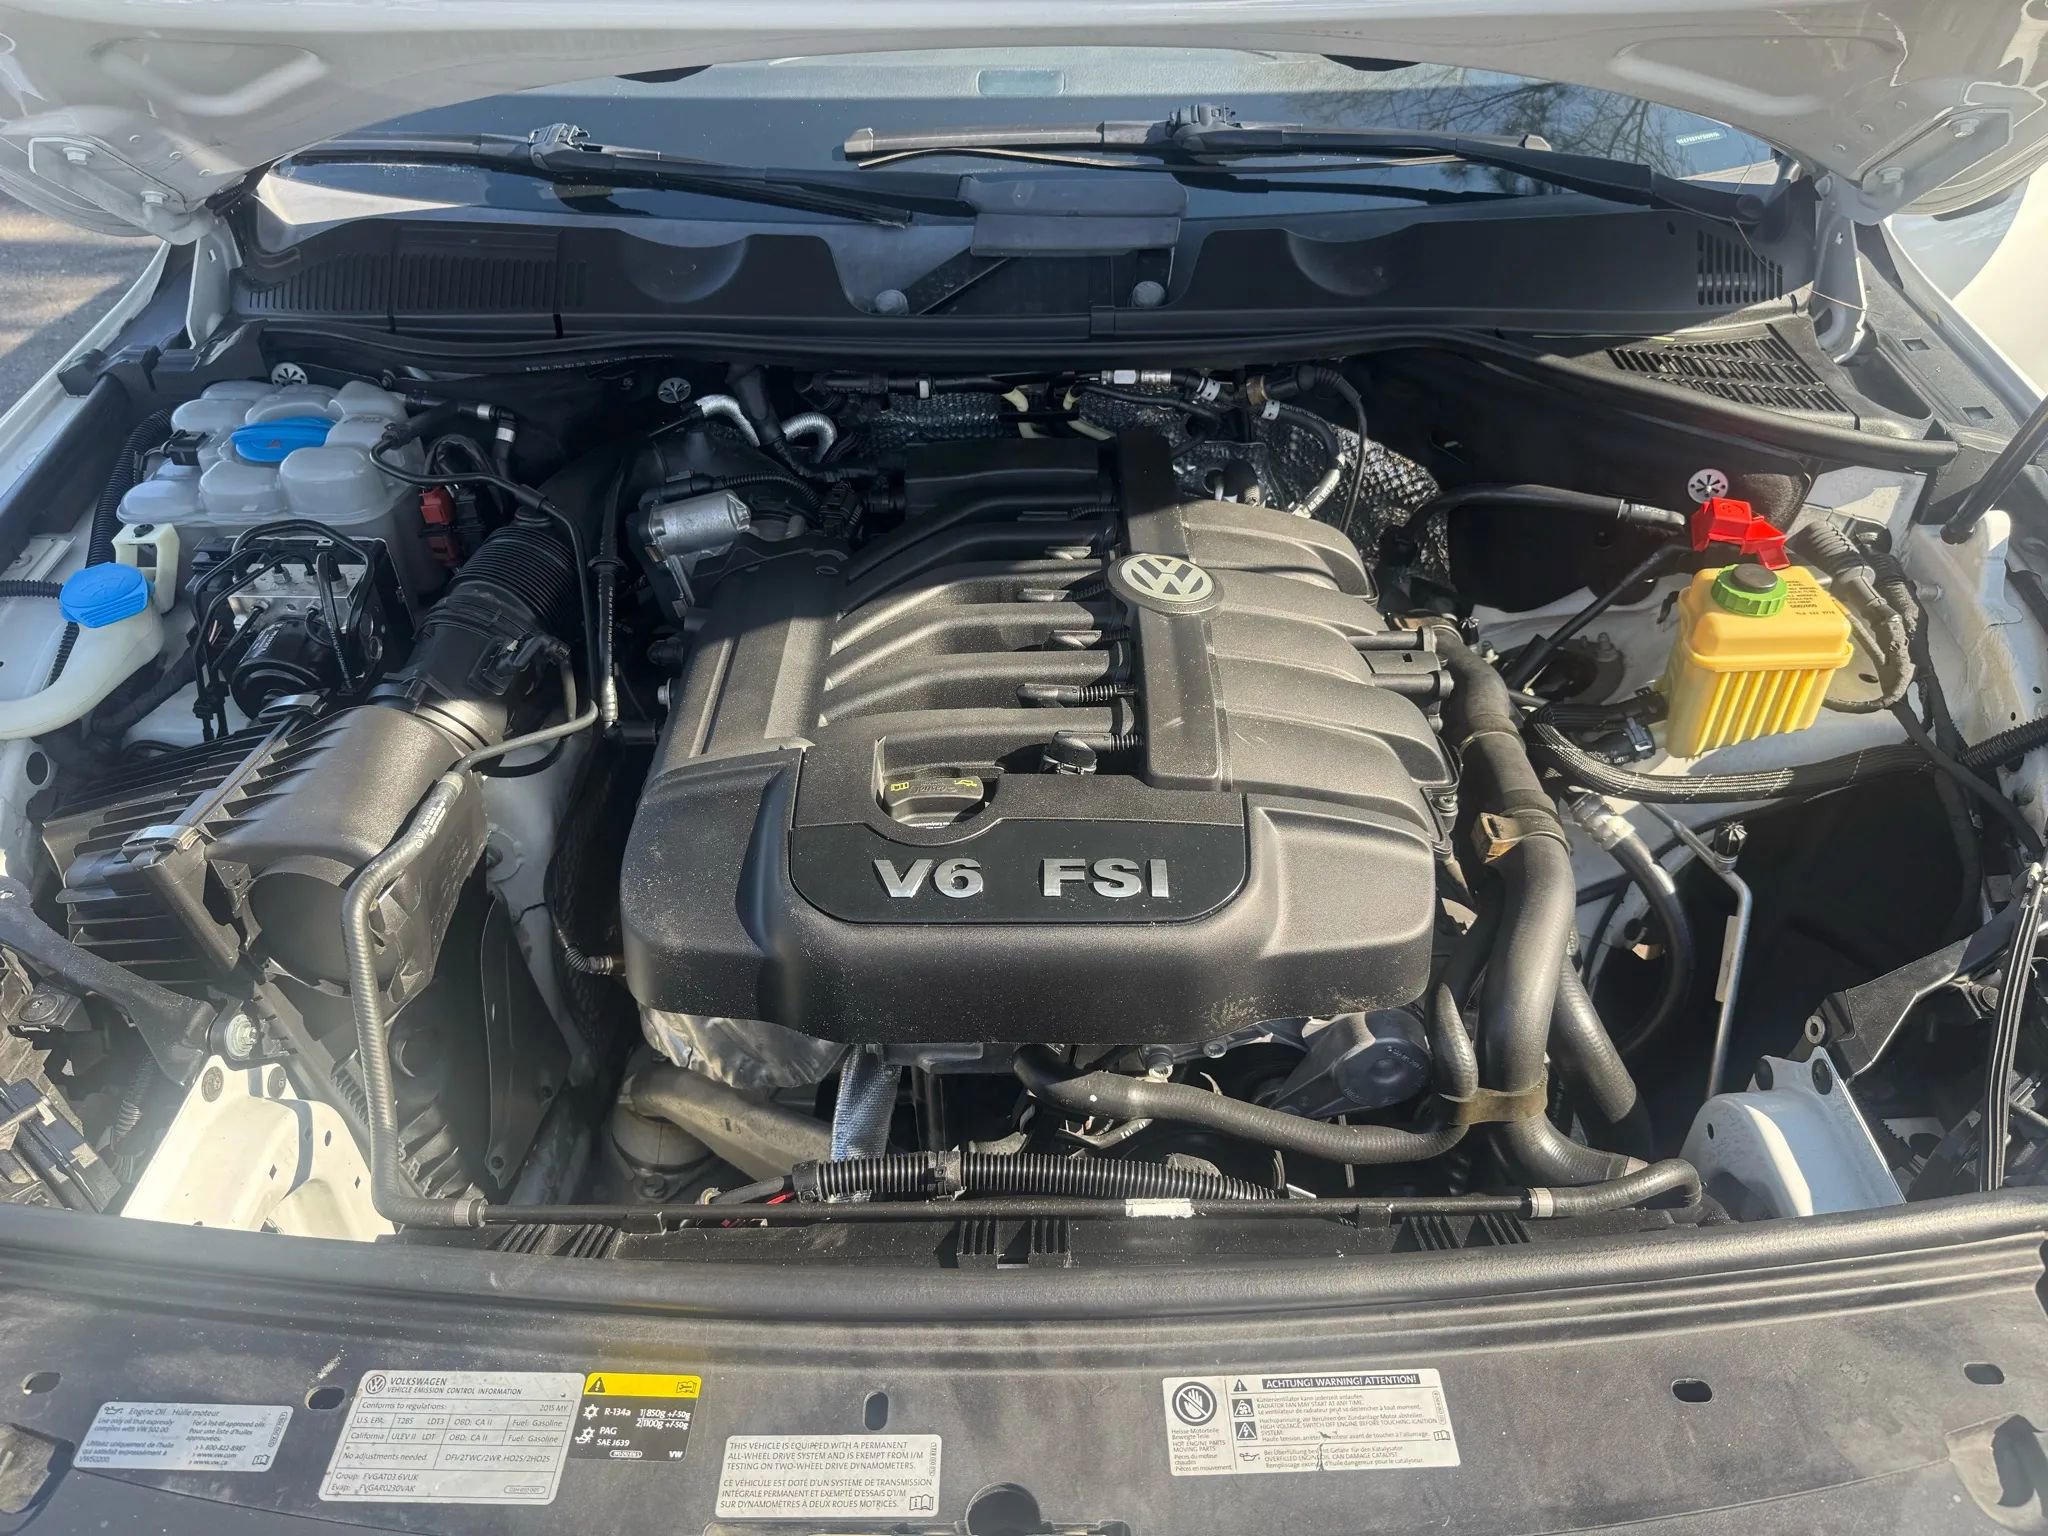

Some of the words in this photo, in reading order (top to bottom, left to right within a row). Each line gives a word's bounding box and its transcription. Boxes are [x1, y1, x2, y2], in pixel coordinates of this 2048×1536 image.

[874, 858, 984, 898] V6
[1041, 858, 1170, 898] FSI
[391, 1377, 448, 1387] VOLKSWAGEN
[1266, 1378, 1314, 1389] ACHTUNG!
[1315, 1376, 1362, 1387] WARNING!
[1364, 1375, 1417, 1385] ATTENTION!
[387, 1386, 412, 1394] VEHICLE
[414, 1387, 444, 1395] EMISSION
[446, 1387, 475, 1395] CONTROL
[478, 1388, 523, 1396] INFORMATION
[362, 1401, 396, 1410] Conforms
[397, 1402, 405, 1410] to
[540, 1405, 555, 1413] 2015
[556, 1405, 569, 1413] MY
[128, 1407, 154, 1418] Engine
[154, 1408, 166, 1416] Oil
[192, 1410, 220, 1418] moteur
[604, 1408, 632, 1416] R-134a
[646, 1409, 666, 1419] 850g
[426, 1417, 445, 1425] LDT3
[475, 1418, 486, 1426] CA
[532, 1419, 564, 1429] Gasoline
[599, 1427, 618, 1435] PAG
[350, 1432, 386, 1440] California
[391, 1432, 410, 1440] ULEV
[421, 1433, 436, 1441] LDT
[470, 1433, 481, 1442] CA
[528, 1434, 559, 1444] Gasoline
[612, 1439, 630, 1447] J639
[729, 1442, 748, 1450] THIS
[749, 1442, 781, 1450] VEHICLE
[782, 1442, 790, 1450] IS
[790, 1442, 830, 1452] EQUIPPED
[831, 1441, 852, 1450] WITH
[853, 1441, 860, 1450] A
[860, 1441, 909, 1450] PERMANENT
[355, 1453, 400, 1462] adjustments
[668, 1450, 683, 1458] VW
[727, 1452, 772, 1460] ALL-WHEEL
[772, 1452, 796, 1460] DRIVE
[796, 1452, 826, 1460] SYSTEM
[827, 1451, 846, 1460] AND
[847, 1451, 855, 1460] IS
[855, 1451, 886, 1460] EXEMPT
[886, 1451, 910, 1460] FROM
[727, 1462, 760, 1470] TESTING
[760, 1462, 773, 1470] ON
[774, 1462, 824, 1470] TWO-WHEEL
[825, 1462, 849, 1470] DRIVE
[723, 1479, 734, 1487] CE
[773, 1479, 787, 1487] EST
[809, 1479, 831, 1487] D'UN
[864, 1478, 875, 1487] DE
[876, 1478, 933, 1487] TRANSMISSION
[763, 1489, 809, 1498] PERMANENT
[810, 1489, 819, 1498] ET
[720, 1500, 737, 1509] SUR
[808, 1500, 831, 1508] DEUX
[832, 1500, 858, 1509] ROUES
